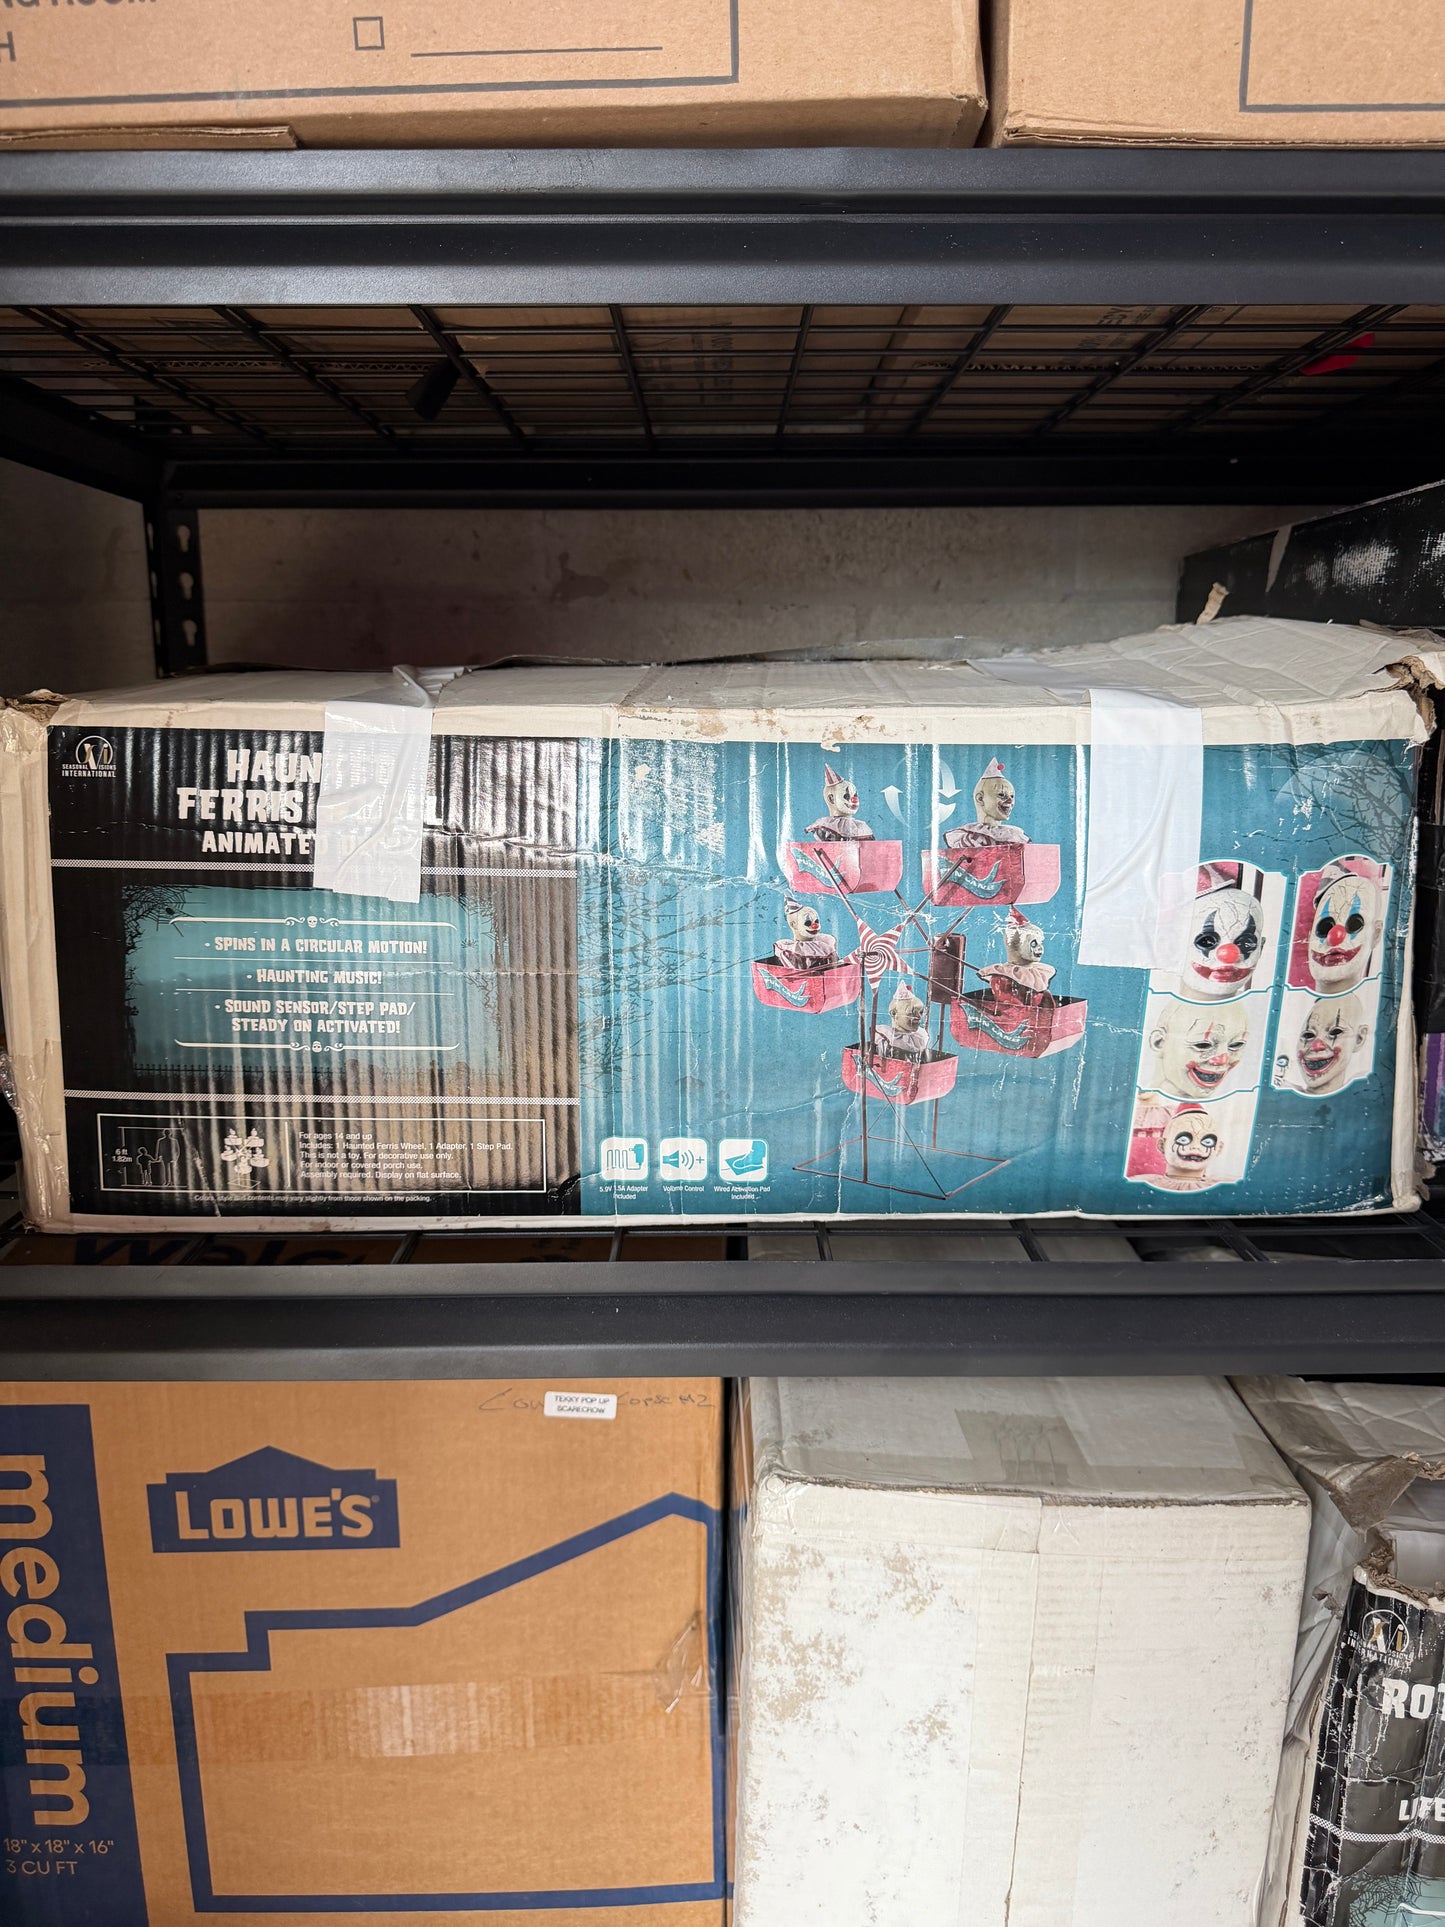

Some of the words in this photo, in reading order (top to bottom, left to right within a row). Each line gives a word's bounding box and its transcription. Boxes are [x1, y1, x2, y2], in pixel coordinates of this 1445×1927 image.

[62, 770, 116, 778] INTERNATIONAL
[227, 749, 322, 783] HAUN
[177, 787, 303, 823] FERRIS
[202, 830, 325, 855] ANIMATE
[214, 937, 256, 952] SPINS
[261, 938, 276, 951] IN
[281, 938, 291, 952] A
[295, 939, 363, 953] CIRCULAR
[368, 940, 428, 954] MOTION!
[256, 969, 329, 983] HAUNTING
[334, 970, 382, 985] MUSIC!
[224, 999, 272, 1013] SOUND
[276, 1000, 375, 1015] SENSOR/STEP
[380, 1002, 416, 1016] PAD/
[231, 1018, 287, 1032] STEADY
[293, 1019, 312, 1033] ON
[317, 1020, 401, 1034] ACTIVATED!
[301, 1151, 316, 1159] This
[348, 1152, 361, 1160] toy.
[383, 1161, 404, 1169] porch
[301, 1171, 337, 1179] Assembly
[339, 1171, 373, 1179] required.
[305, 1195, 327, 1203] slightly
[405, 1195, 431, 1203] packing.
[175, 1487, 374, 1540] LOWE'S
[0, 1454, 99, 1826] medium
[3, 1838, 27, 1854] 18"
[31, 1843, 42, 1854] x
[45, 1839, 70, 1854] 18"
[74, 1843, 85, 1854] x
[89, 1840, 114, 1854] 16"
[6, 1859, 17, 1874] 3
[21, 1860, 51, 1875] CU
[56, 1861, 78, 1875] FT
